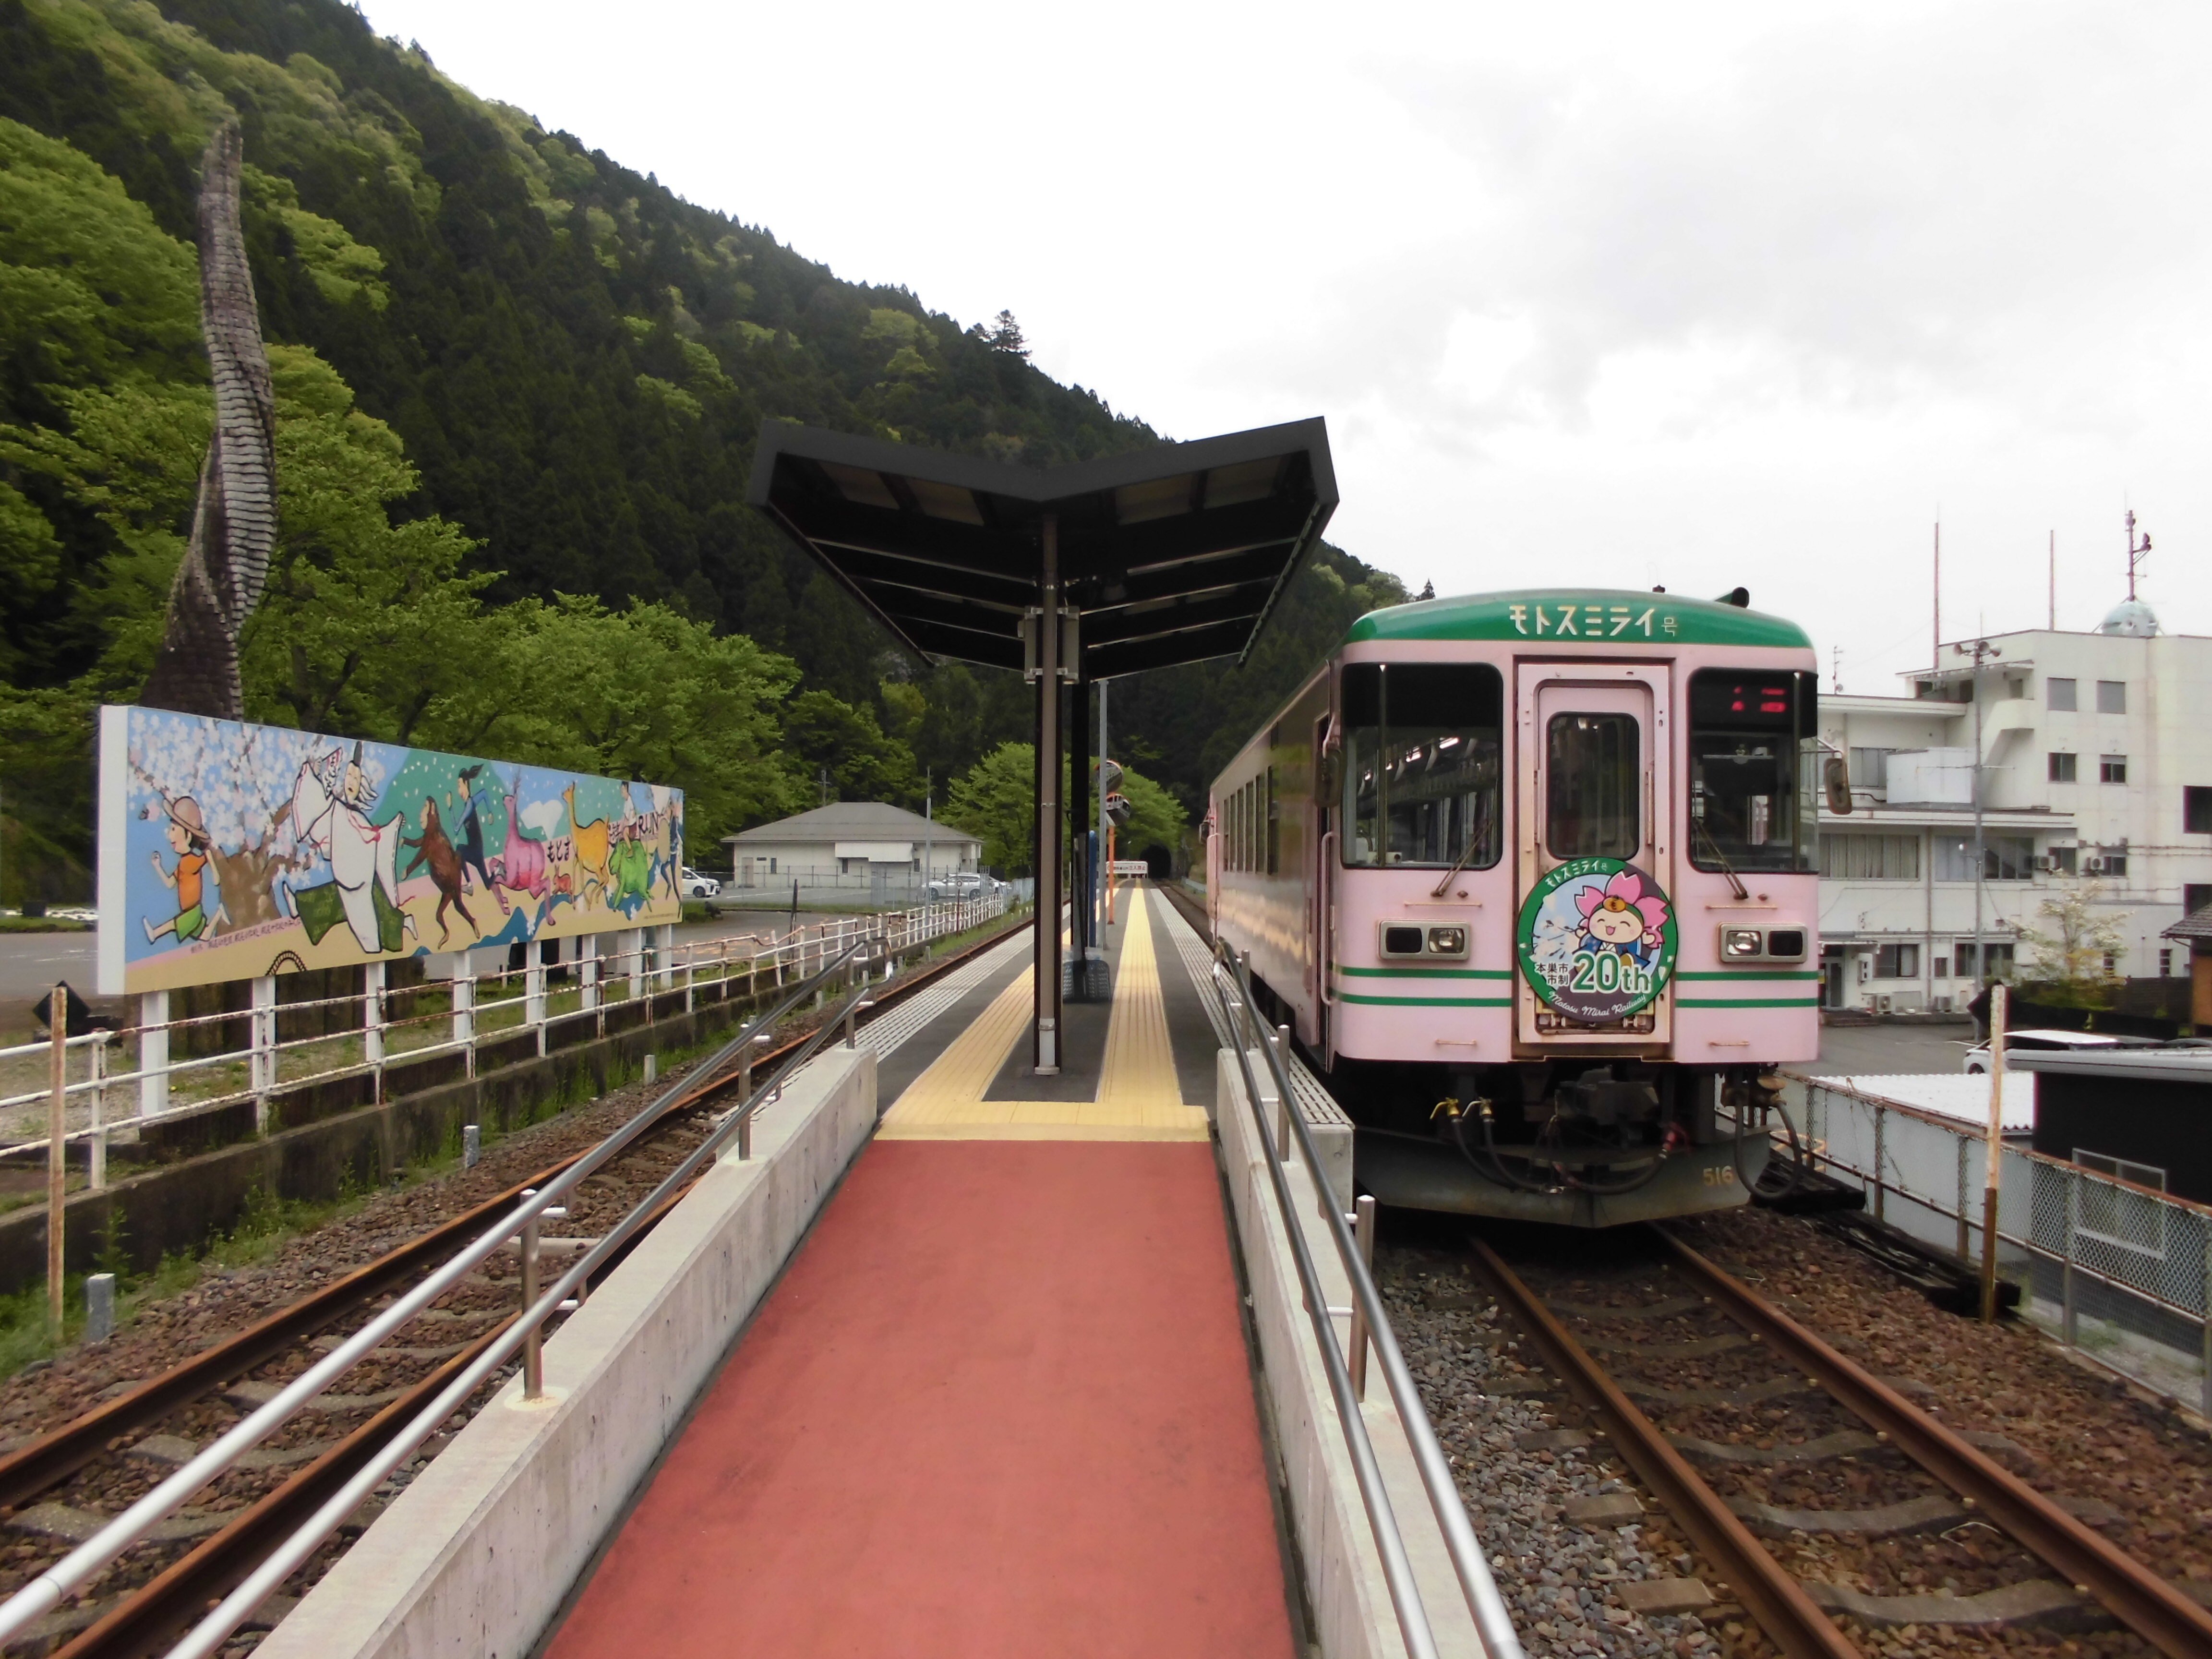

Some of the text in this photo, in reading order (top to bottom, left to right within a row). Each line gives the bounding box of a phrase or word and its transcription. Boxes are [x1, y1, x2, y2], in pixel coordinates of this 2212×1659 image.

[1509, 605, 1678, 637] モトスミライ号
[1545, 860, 1608, 887] モトスミライ号
[1536, 962, 1569, 974] 本巣市
[1547, 974, 1569, 985] 市制
[1572, 952, 1650, 992] 20th
[1548, 991, 1647, 1017] Motosu Mirai Railway
[1703, 1165, 1734, 1186] 516
